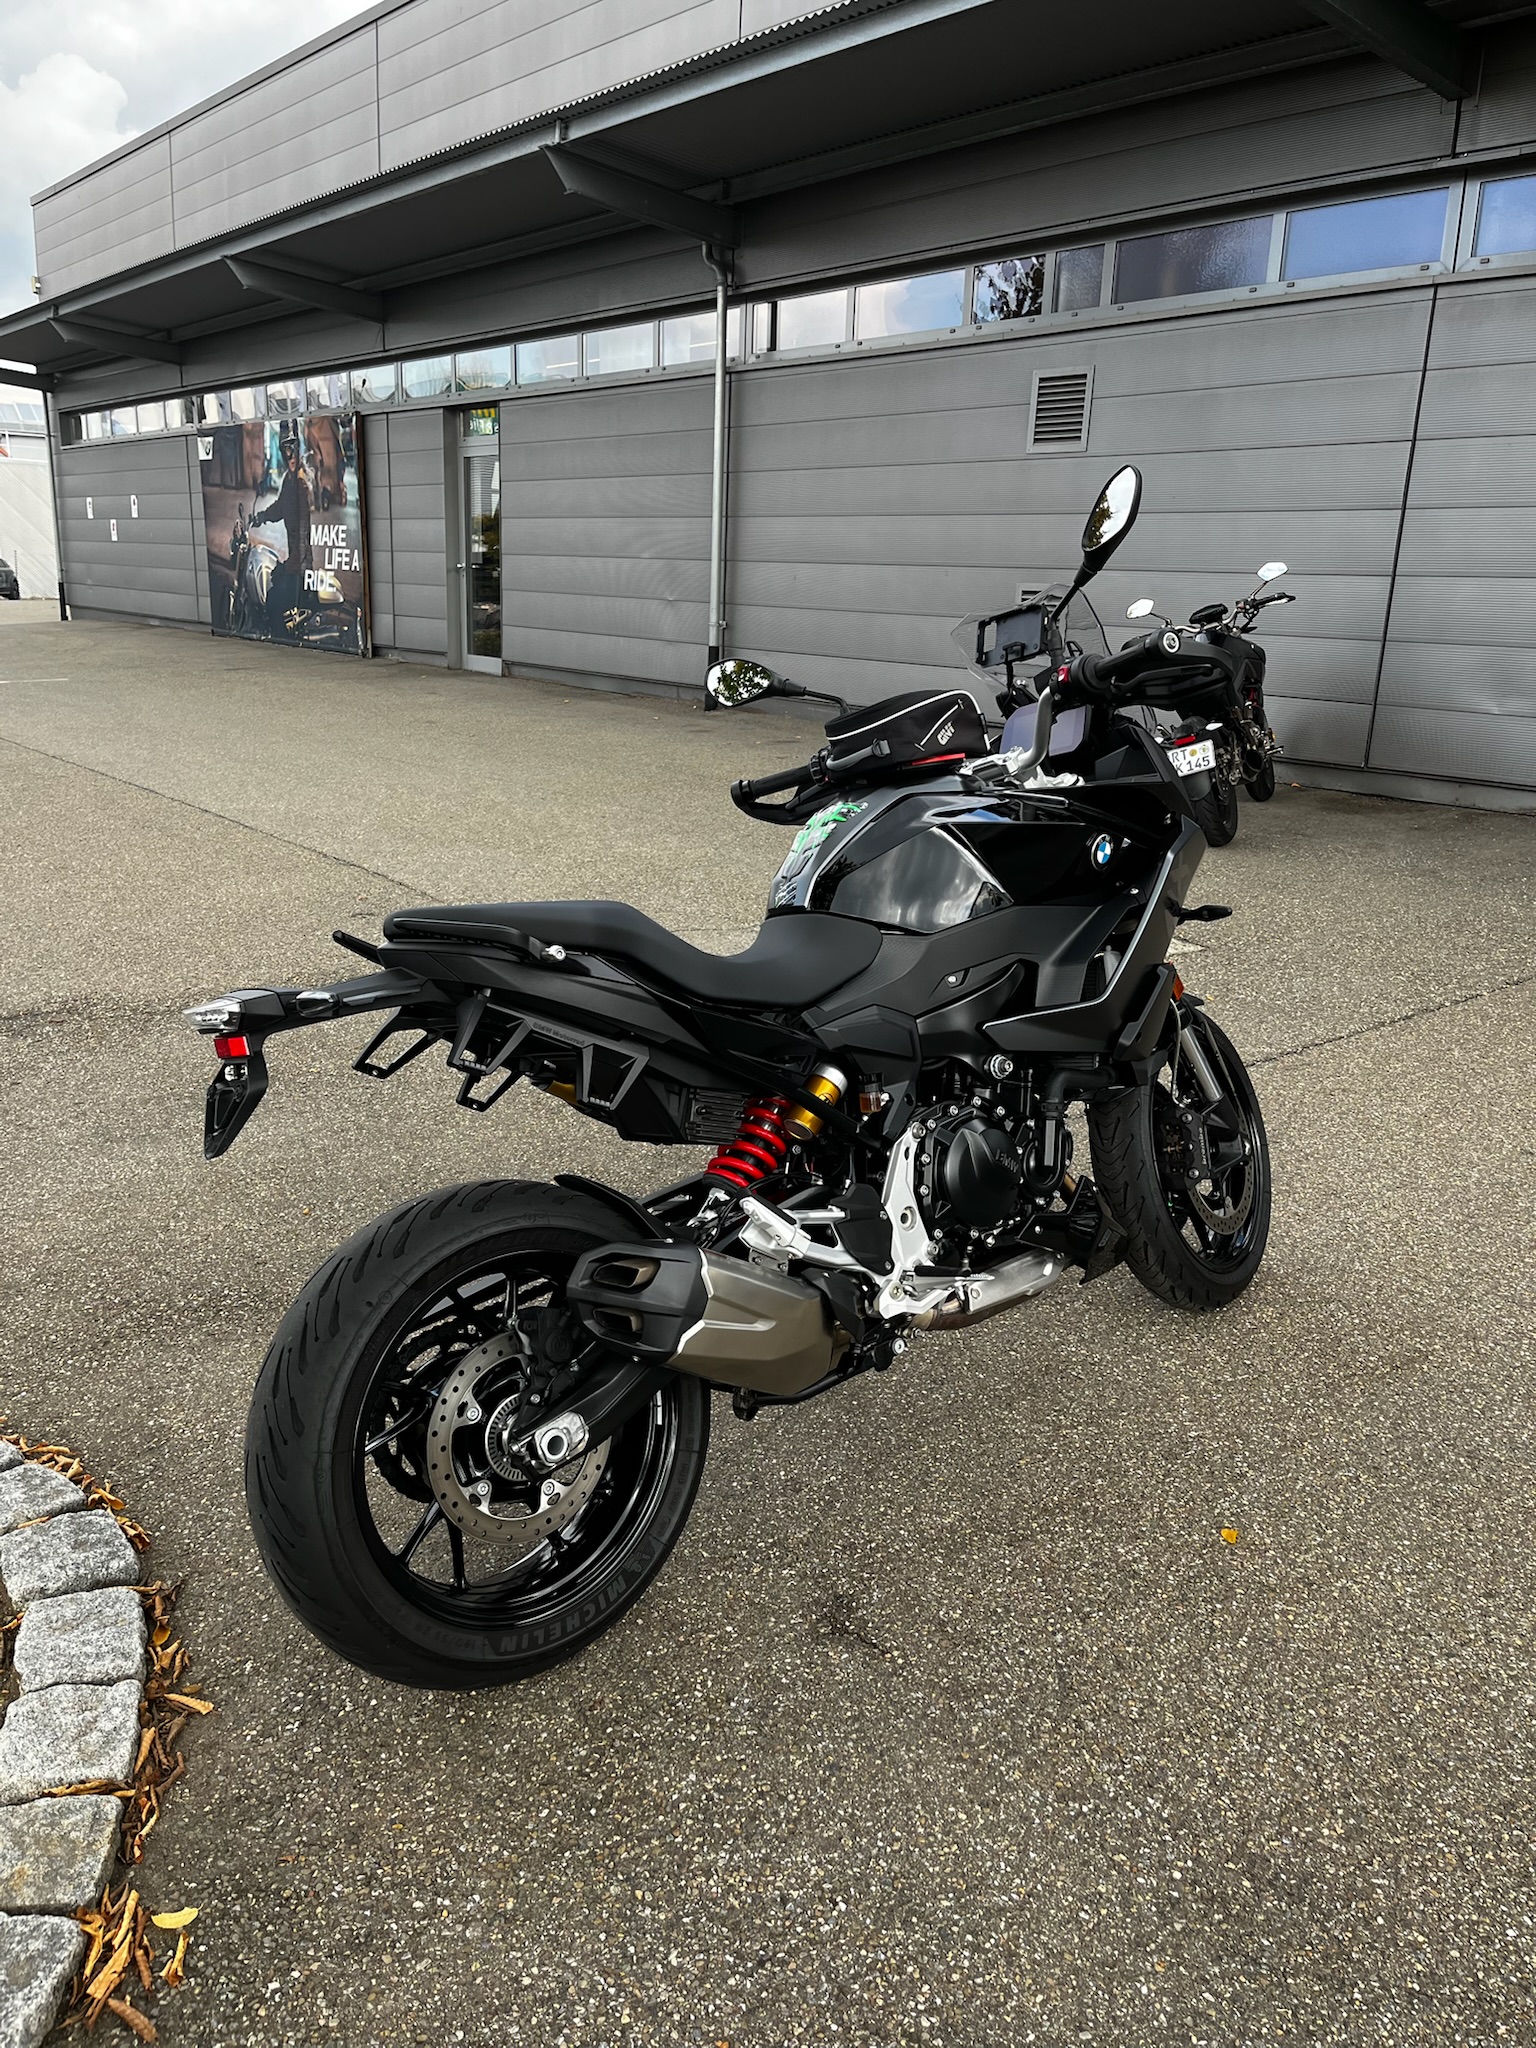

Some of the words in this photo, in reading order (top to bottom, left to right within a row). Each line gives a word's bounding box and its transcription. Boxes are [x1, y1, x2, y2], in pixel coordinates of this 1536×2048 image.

[310, 524, 347, 546] MAKE
[324, 547, 350, 570] LIFE
[351, 549, 360, 571] A
[303, 569, 337, 592] RIDE.
[936, 720, 955, 745] GIVI
[1171, 748, 1187, 763] RT
[1186, 755, 1210, 772] 145
[500, 1574, 628, 1654] MICHELIN
